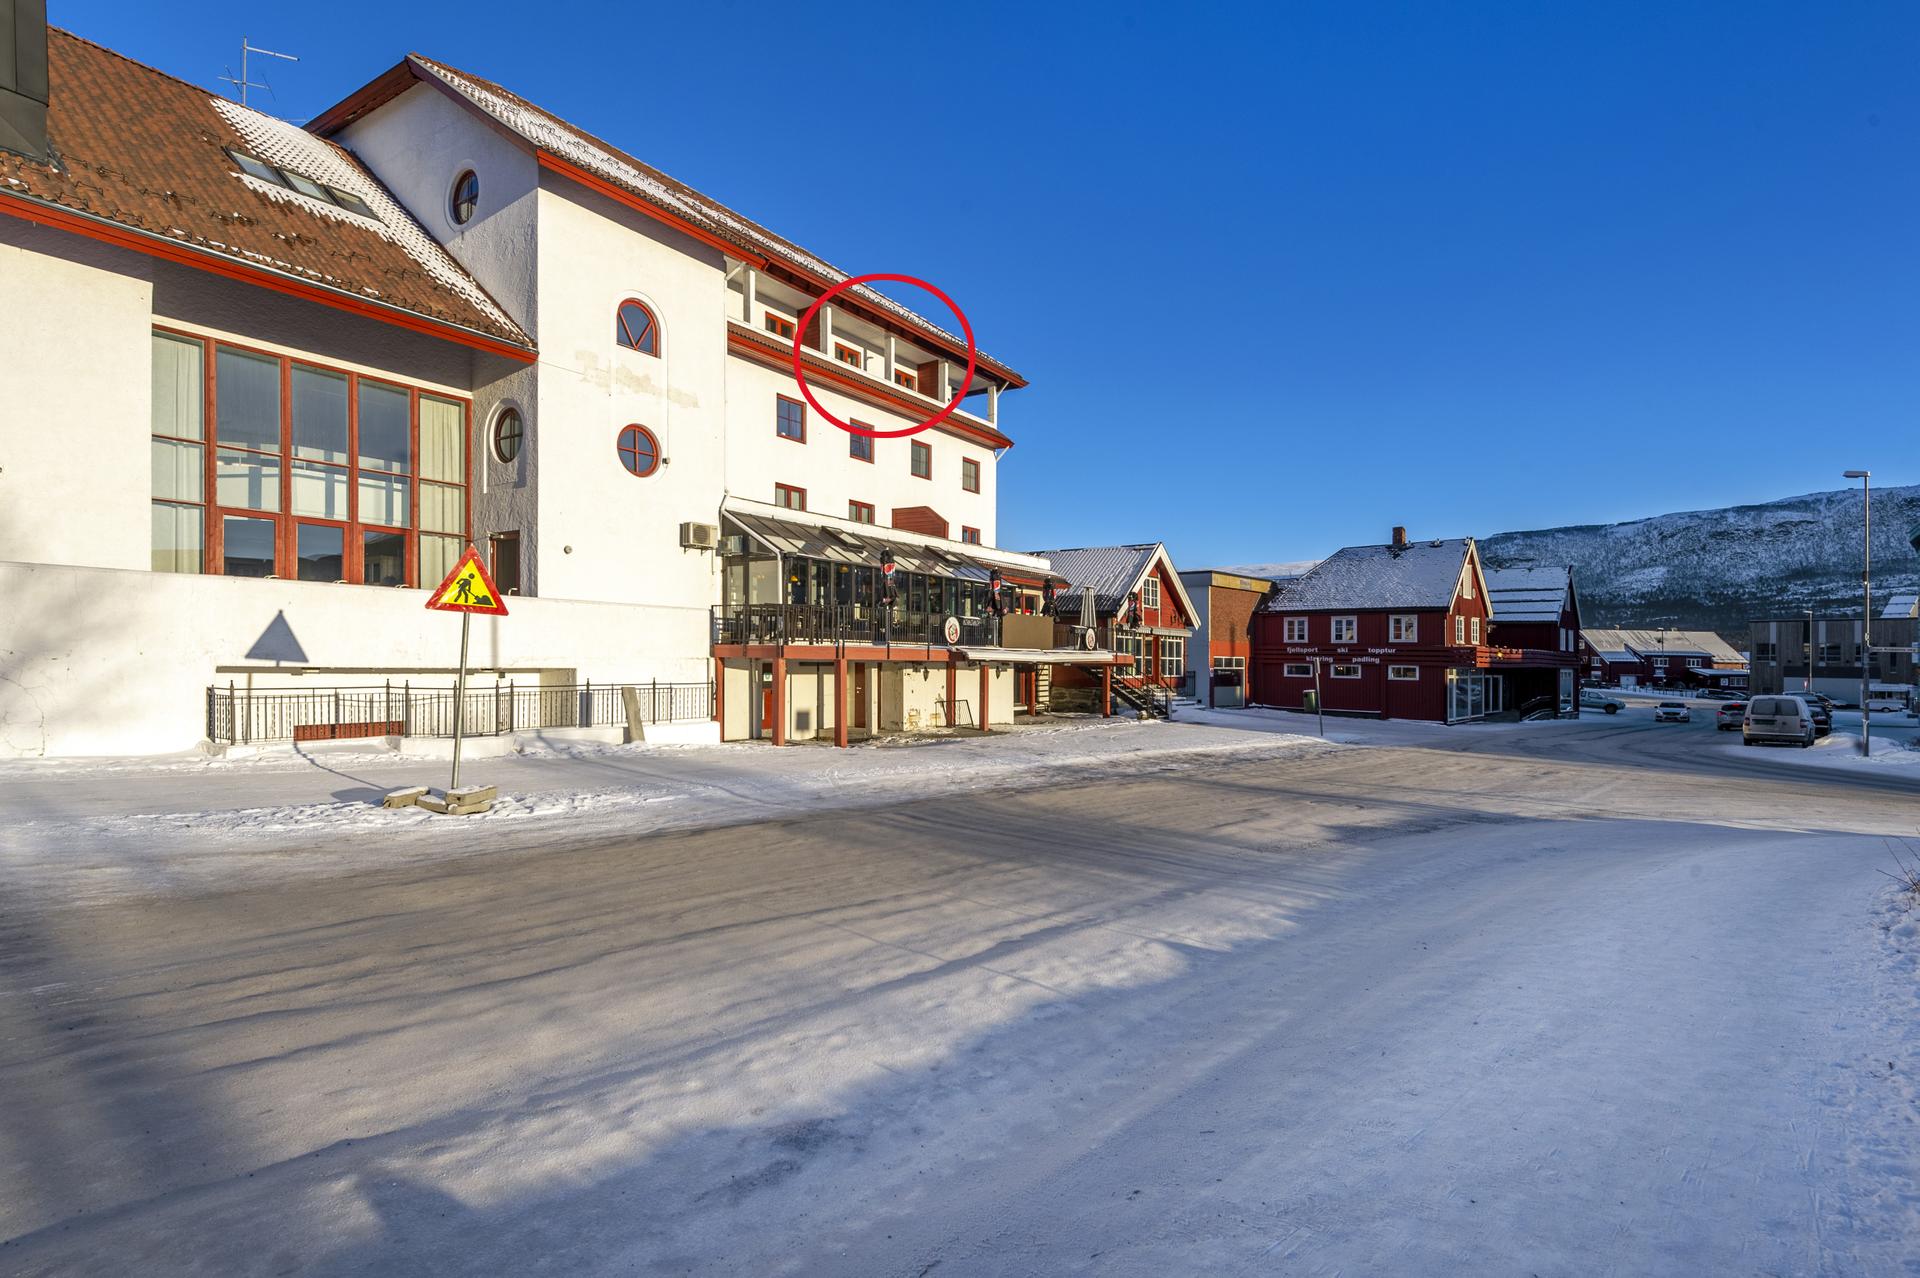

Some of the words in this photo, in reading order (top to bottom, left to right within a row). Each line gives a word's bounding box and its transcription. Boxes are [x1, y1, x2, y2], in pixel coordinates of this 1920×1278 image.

[1286, 646, 1318, 654] fjellsport
[1367, 647, 1396, 655] topptur
[1352, 656, 1380, 664] padling
